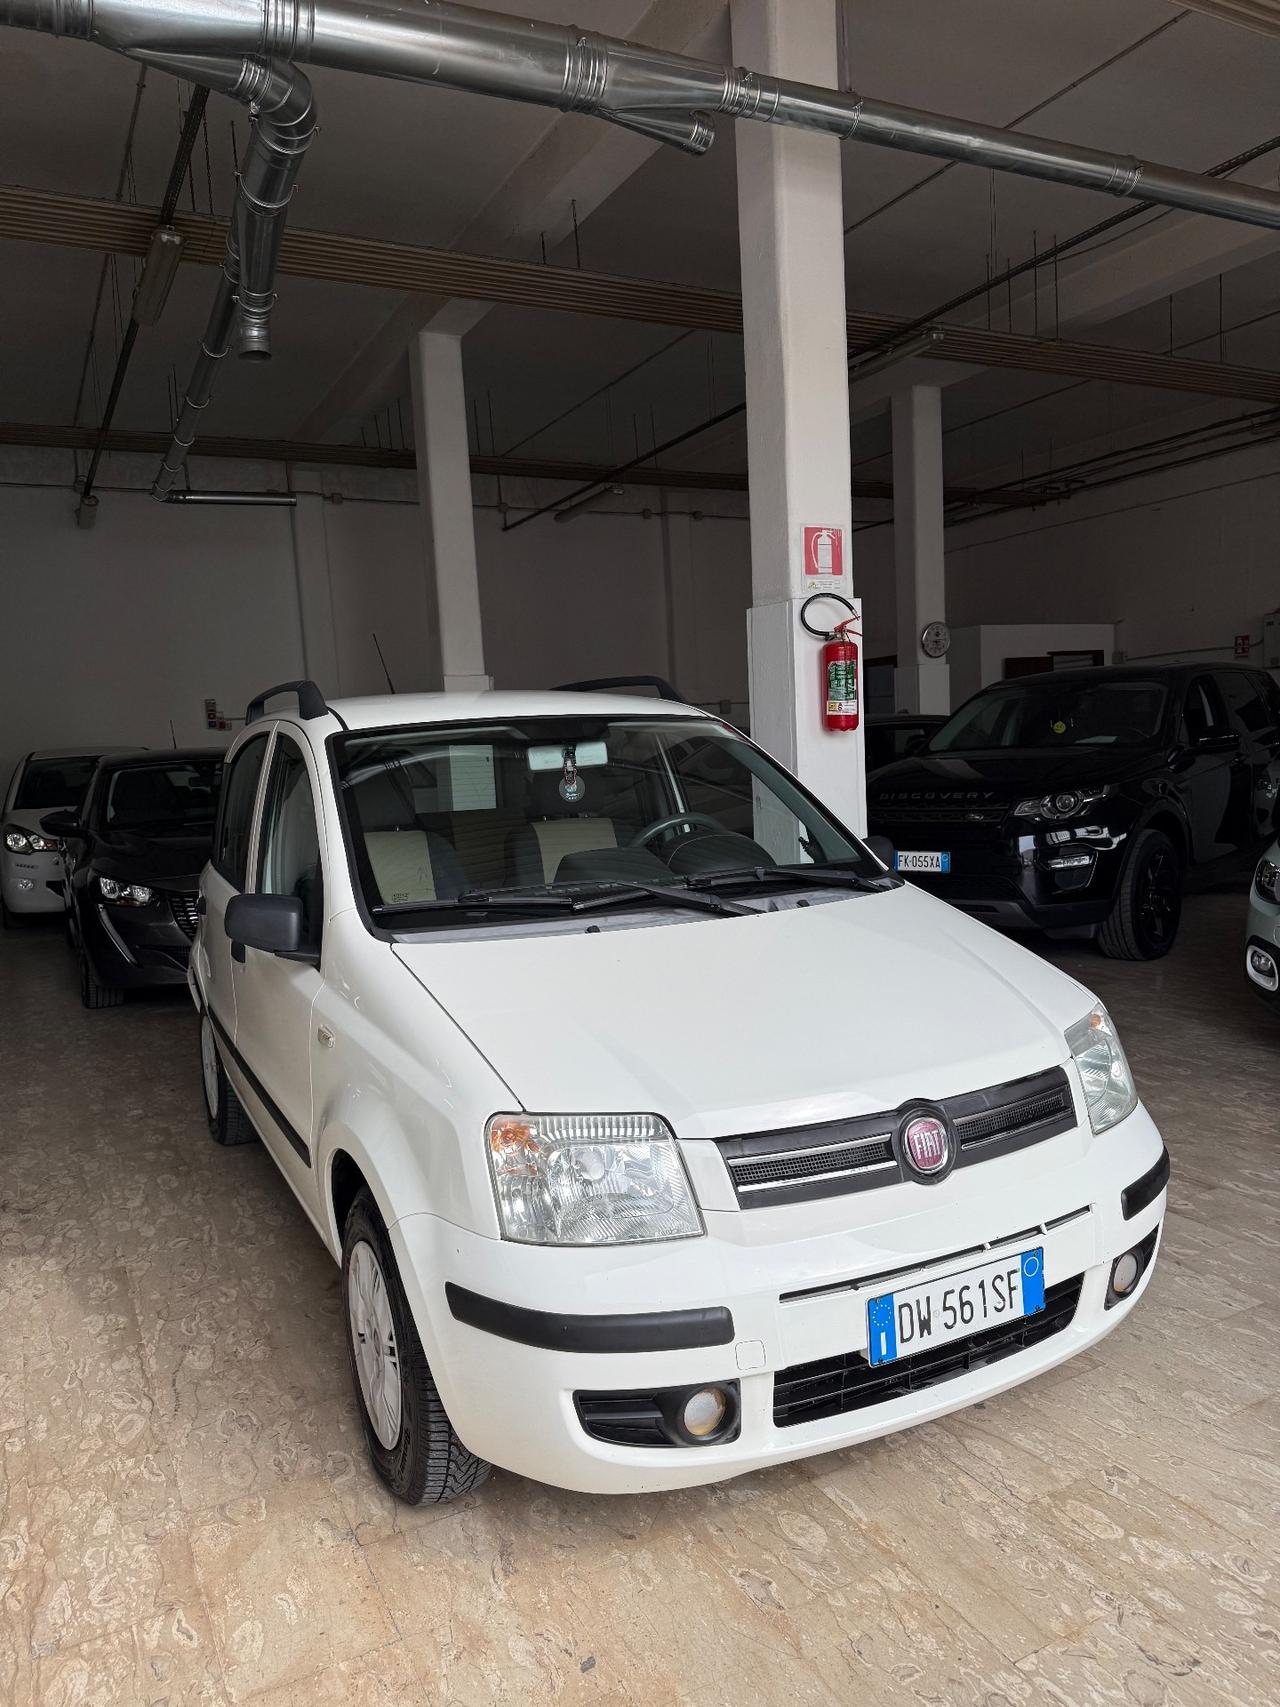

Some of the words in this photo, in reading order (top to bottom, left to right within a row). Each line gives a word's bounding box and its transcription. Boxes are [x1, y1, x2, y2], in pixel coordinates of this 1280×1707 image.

[879, 791, 995, 800] DISCOVERY
[912, 854, 940, 868] 055XA
[913, 1129, 941, 1160] FIAT
[898, 1295, 932, 1344] DW
[942, 1267, 1020, 1330] 561SF
